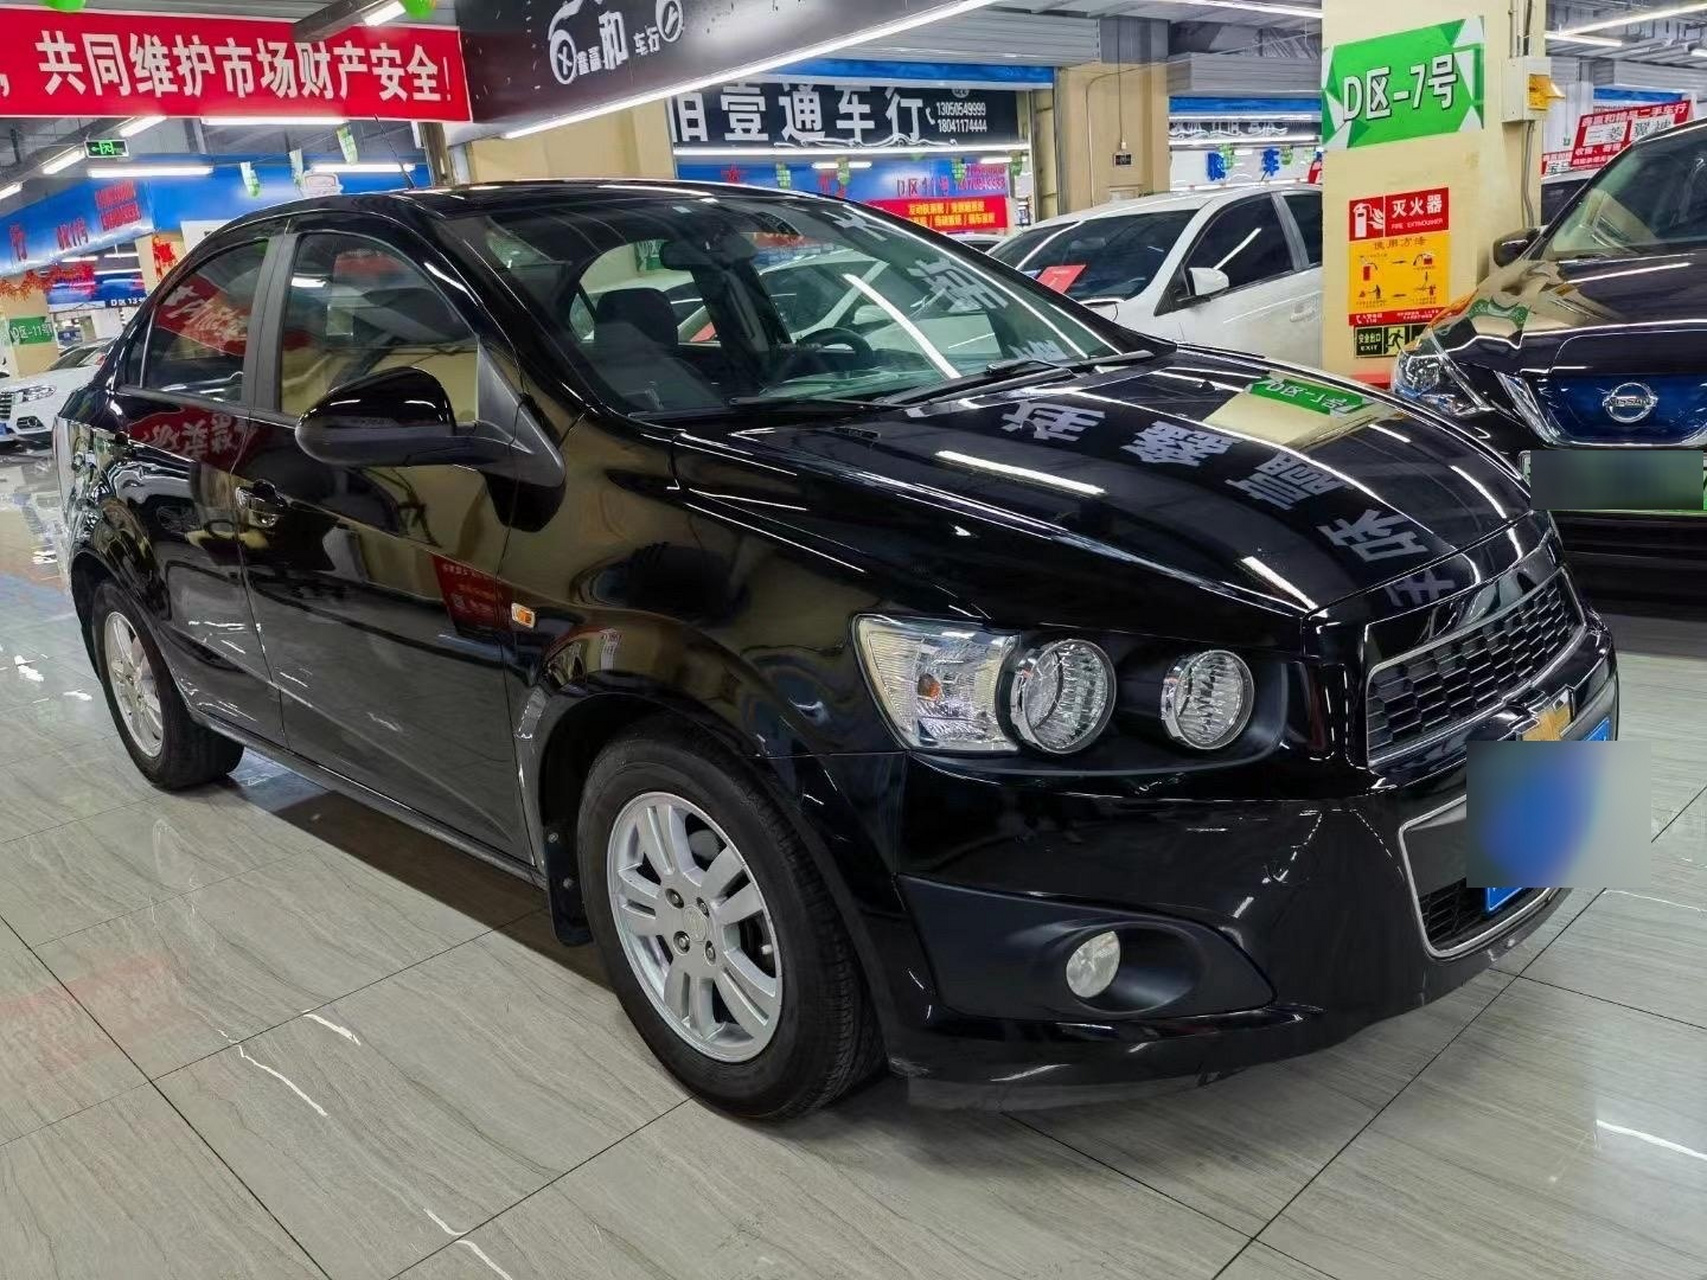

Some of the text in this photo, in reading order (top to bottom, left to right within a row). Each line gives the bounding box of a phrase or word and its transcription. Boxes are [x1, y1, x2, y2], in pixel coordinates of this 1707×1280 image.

[1343, 53, 1459, 122] D区-7号
[1391, 193, 1442, 218] 灭火器
